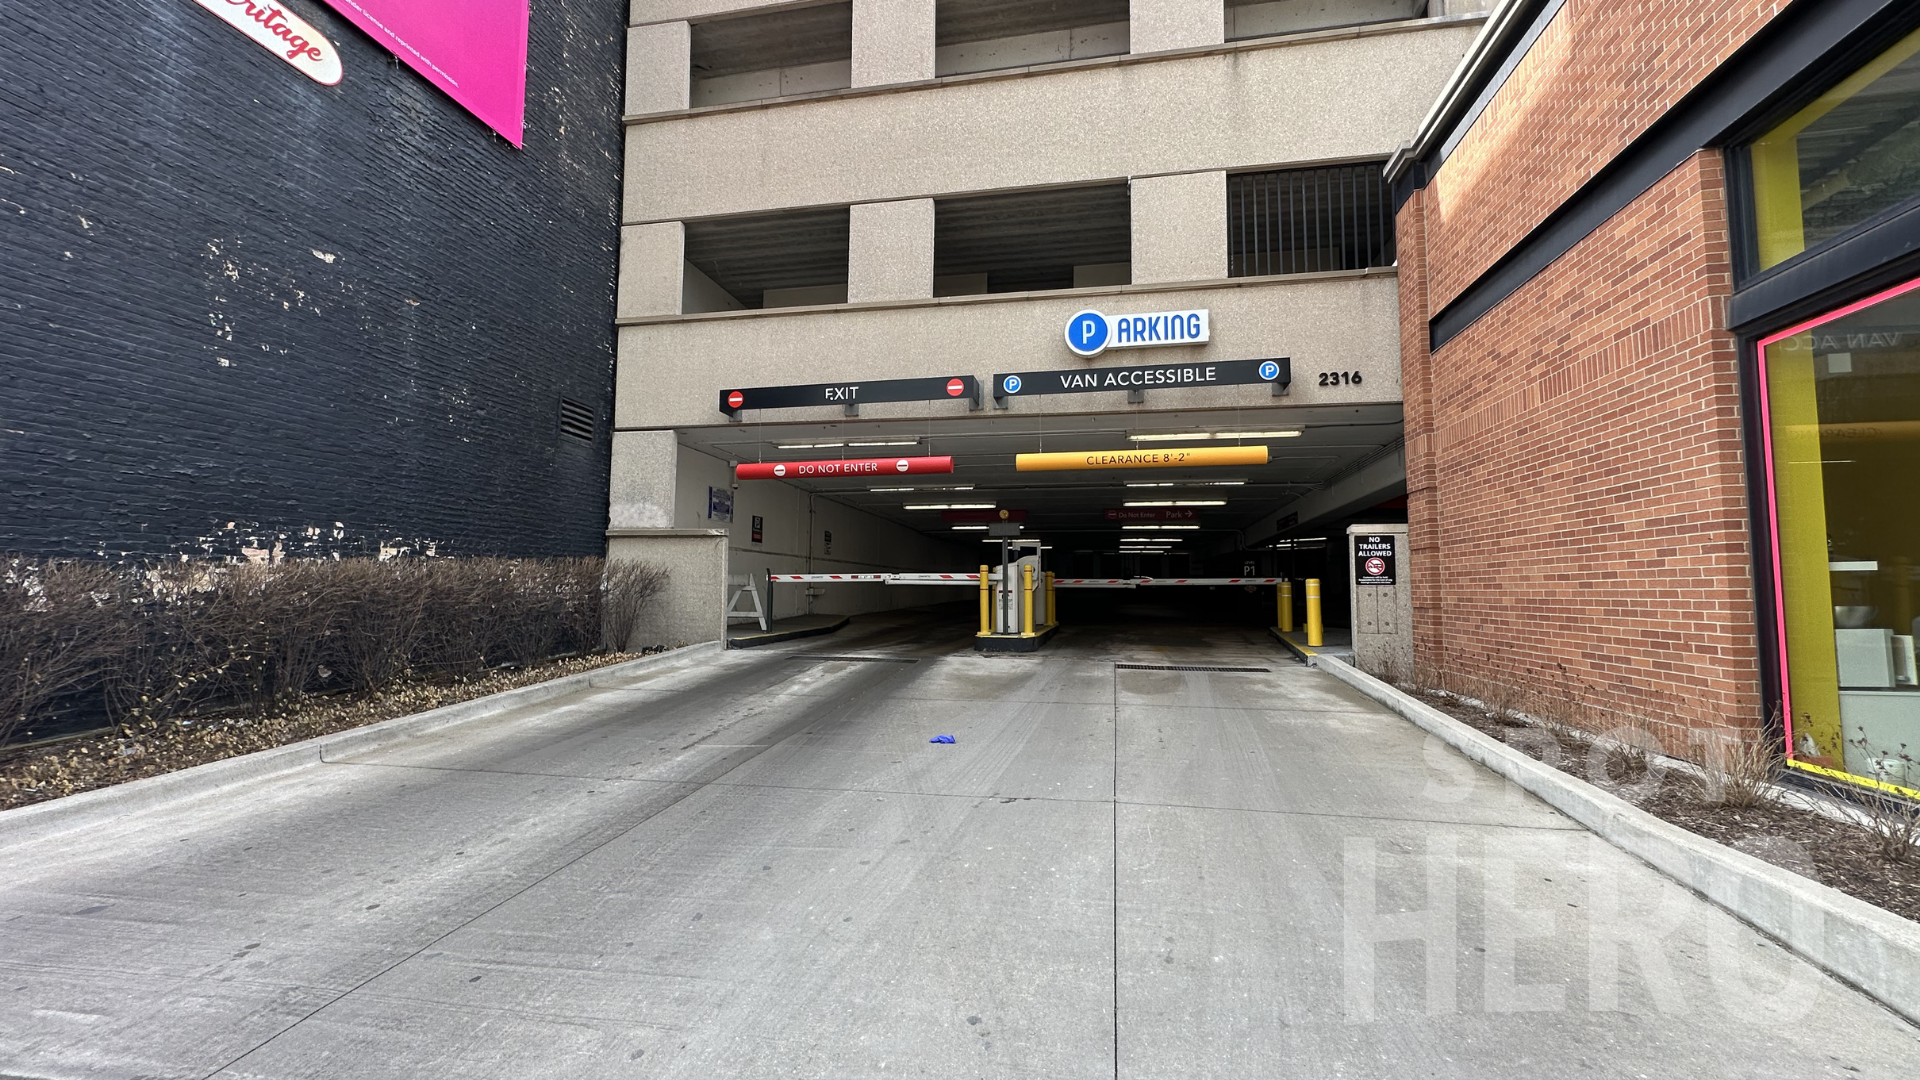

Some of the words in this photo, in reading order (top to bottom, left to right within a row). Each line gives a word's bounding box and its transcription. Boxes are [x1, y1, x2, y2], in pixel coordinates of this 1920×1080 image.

[225, 0, 323, 62] ritage
[1060, 373, 1098, 389] VAN
[1103, 366, 1217, 387] ACCESSIBLE
[1318, 371, 1363, 387] 2316
[825, 386, 859, 400] EXIT
[1086, 454, 1159, 466] CLEARANCE
[1162, 452, 1191, 463] 8'-2"
[798, 465, 815, 475] DO
[818, 464, 840, 474] NOT
[843, 462, 878, 473] ENTER
[1165, 510, 1183, 519] Park
[1243, 565, 1256, 576] P1
